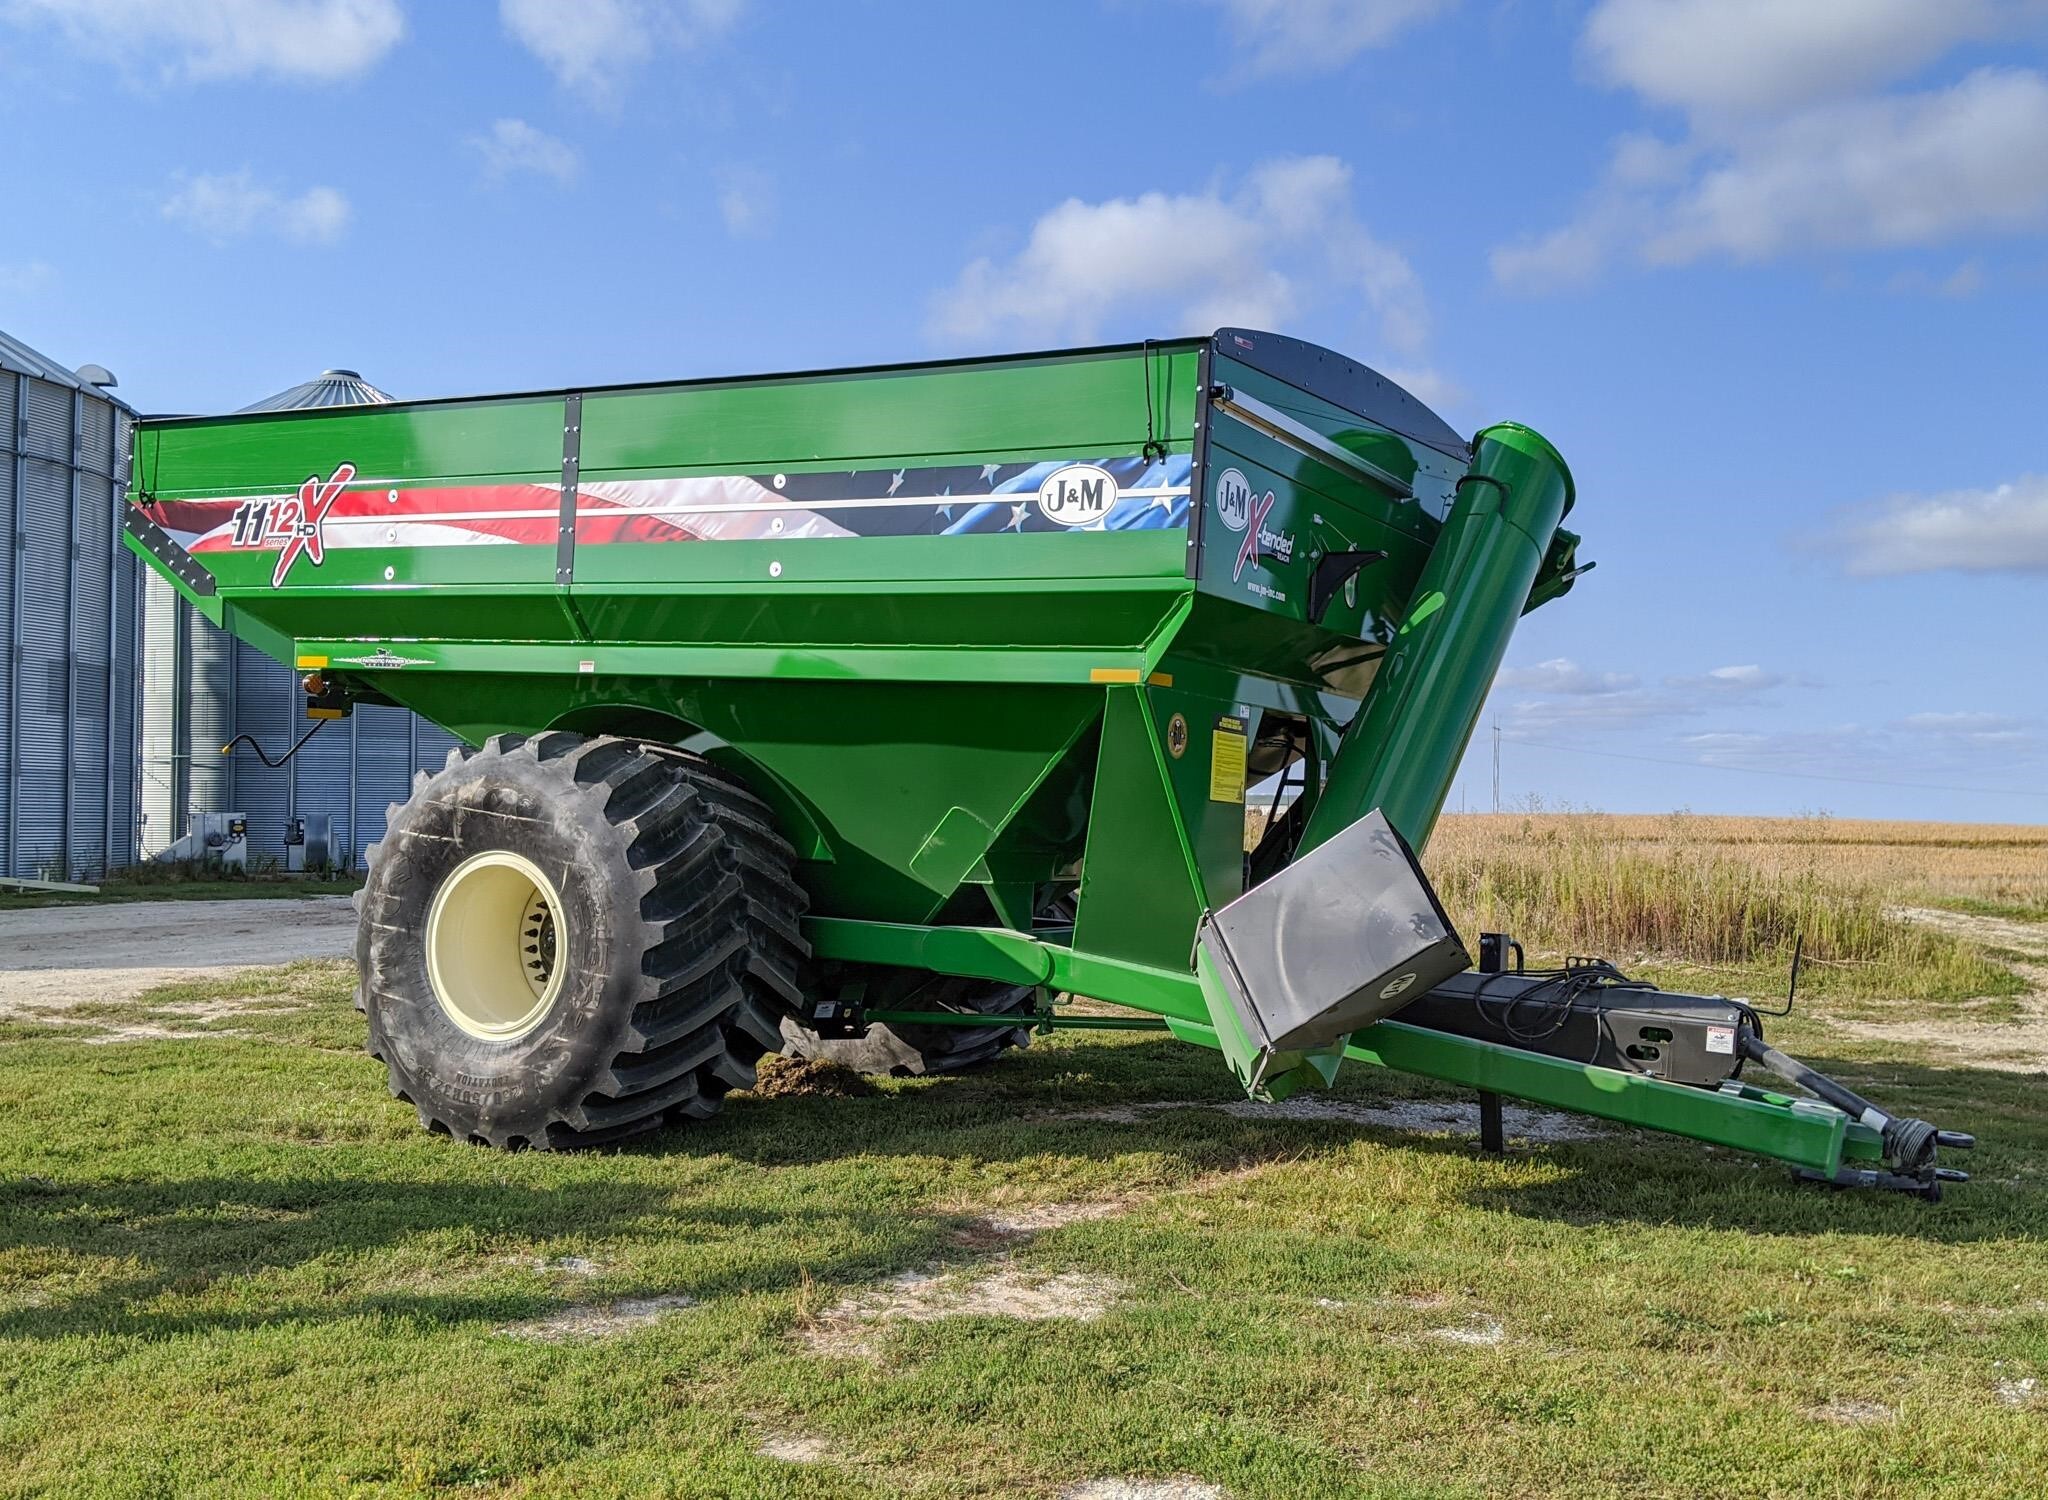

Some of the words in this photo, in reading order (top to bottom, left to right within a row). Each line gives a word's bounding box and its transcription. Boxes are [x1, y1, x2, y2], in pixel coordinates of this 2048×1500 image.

[1047, 478, 1105, 512] J&M
[1220, 481, 1247, 520] J&M
[296, 523, 316, 536] HD
[265, 537, 288, 547] series
